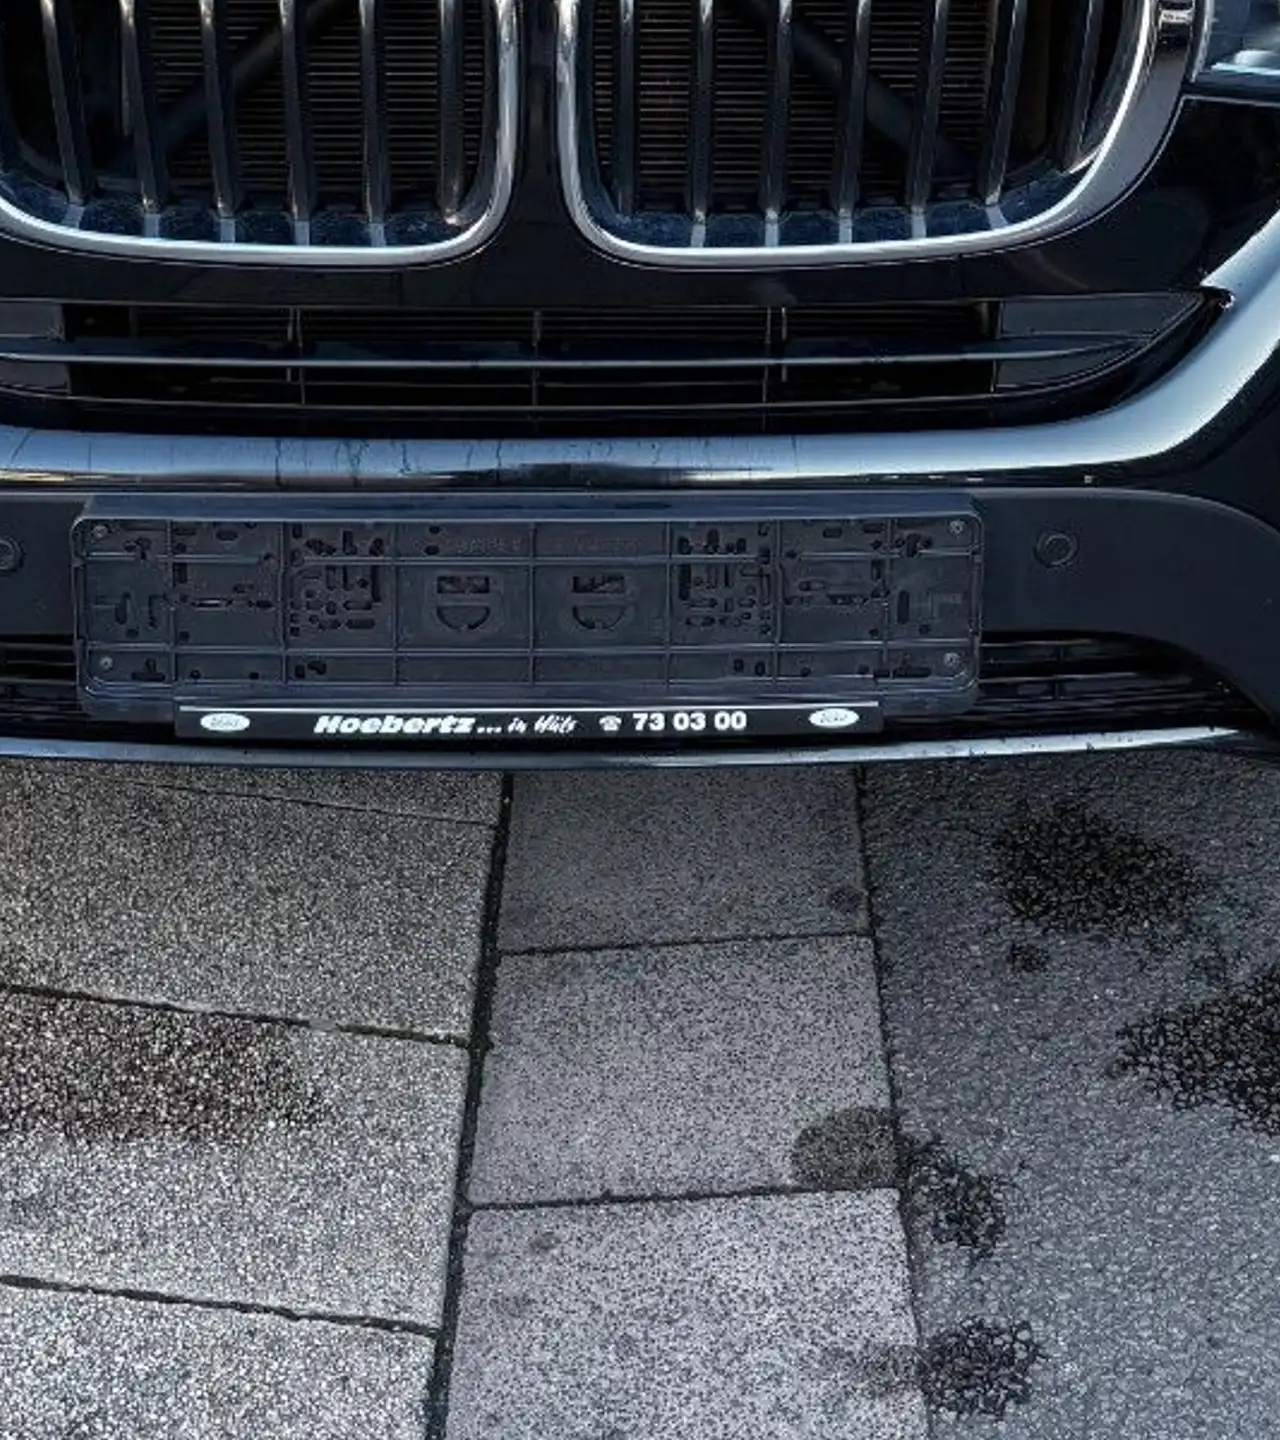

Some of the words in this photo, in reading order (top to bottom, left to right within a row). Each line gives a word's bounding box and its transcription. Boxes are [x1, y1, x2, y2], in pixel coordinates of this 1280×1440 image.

[632, 713, 665, 731] 73
[672, 712, 706, 731] 03
[713, 711, 747, 730] 00
